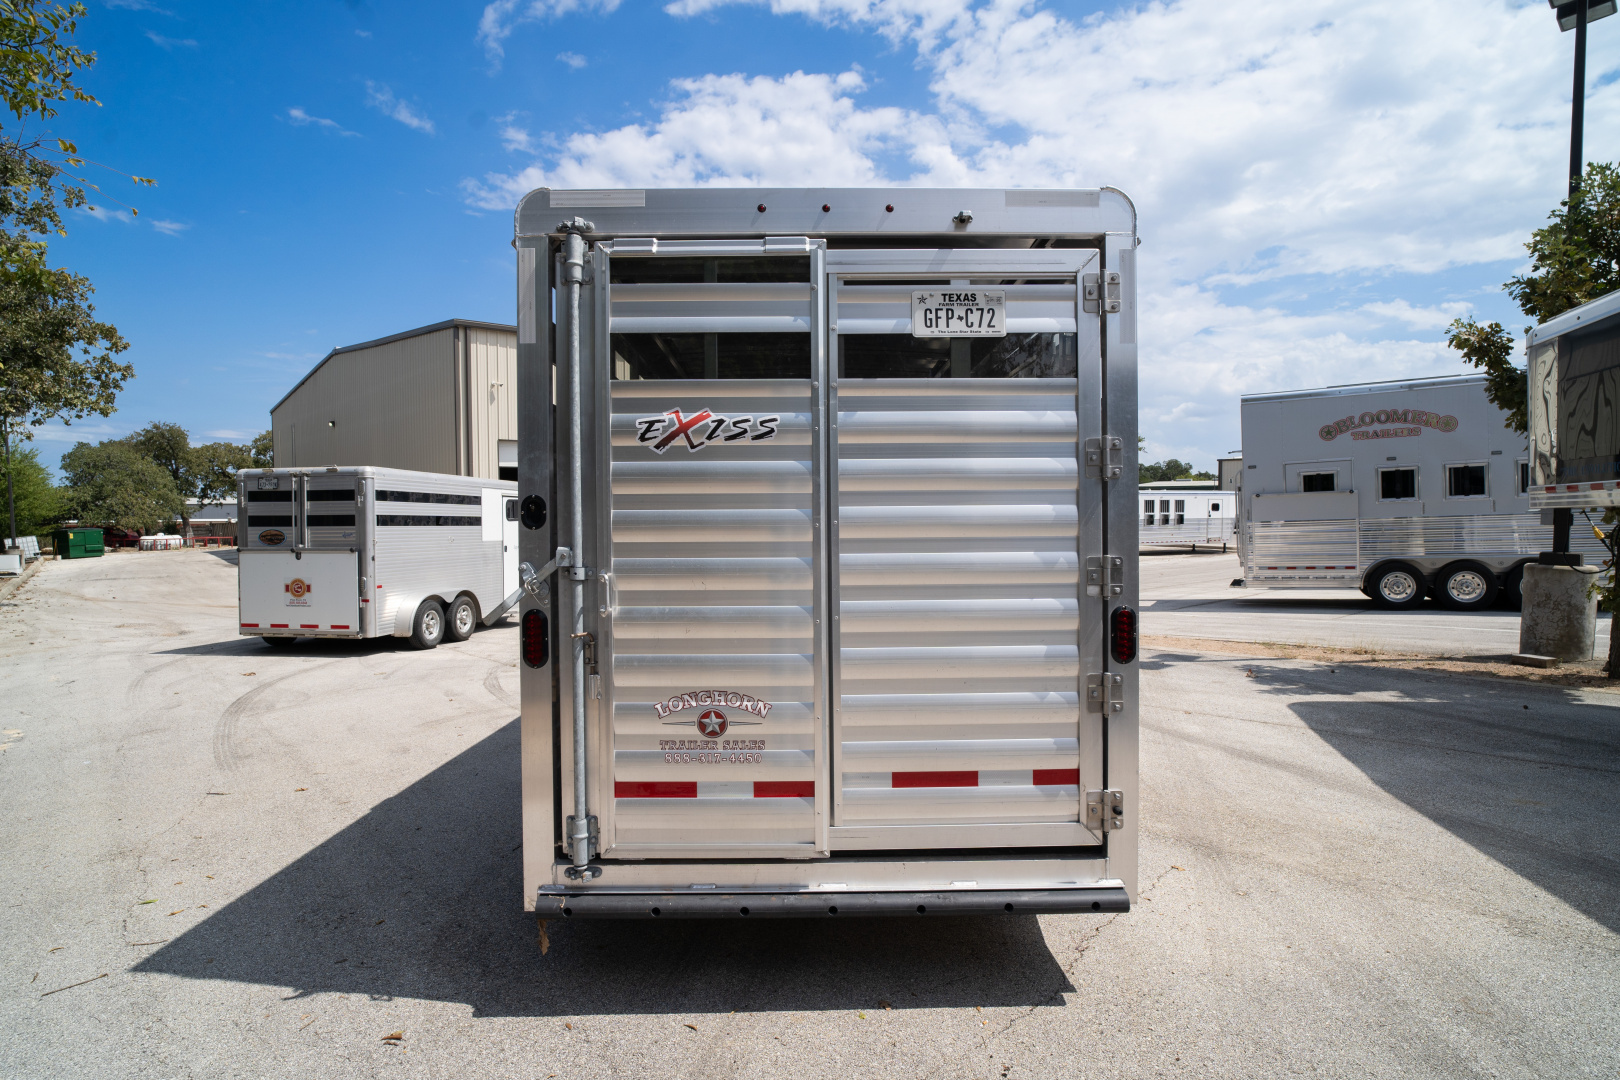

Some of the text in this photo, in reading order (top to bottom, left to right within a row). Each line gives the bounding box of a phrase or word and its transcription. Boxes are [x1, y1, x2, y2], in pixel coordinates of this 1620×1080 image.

[941, 293, 977, 302] TEXAS
[924, 308, 996, 328] GFP C72
[1333, 409, 1441, 435] BLOOMER
[1350, 427, 1421, 440] TRAILERS
[653, 690, 772, 719] LONGHORN
[659, 740, 766, 751] TRAILER SALES
[664, 753, 762, 764] 888-317-4450
